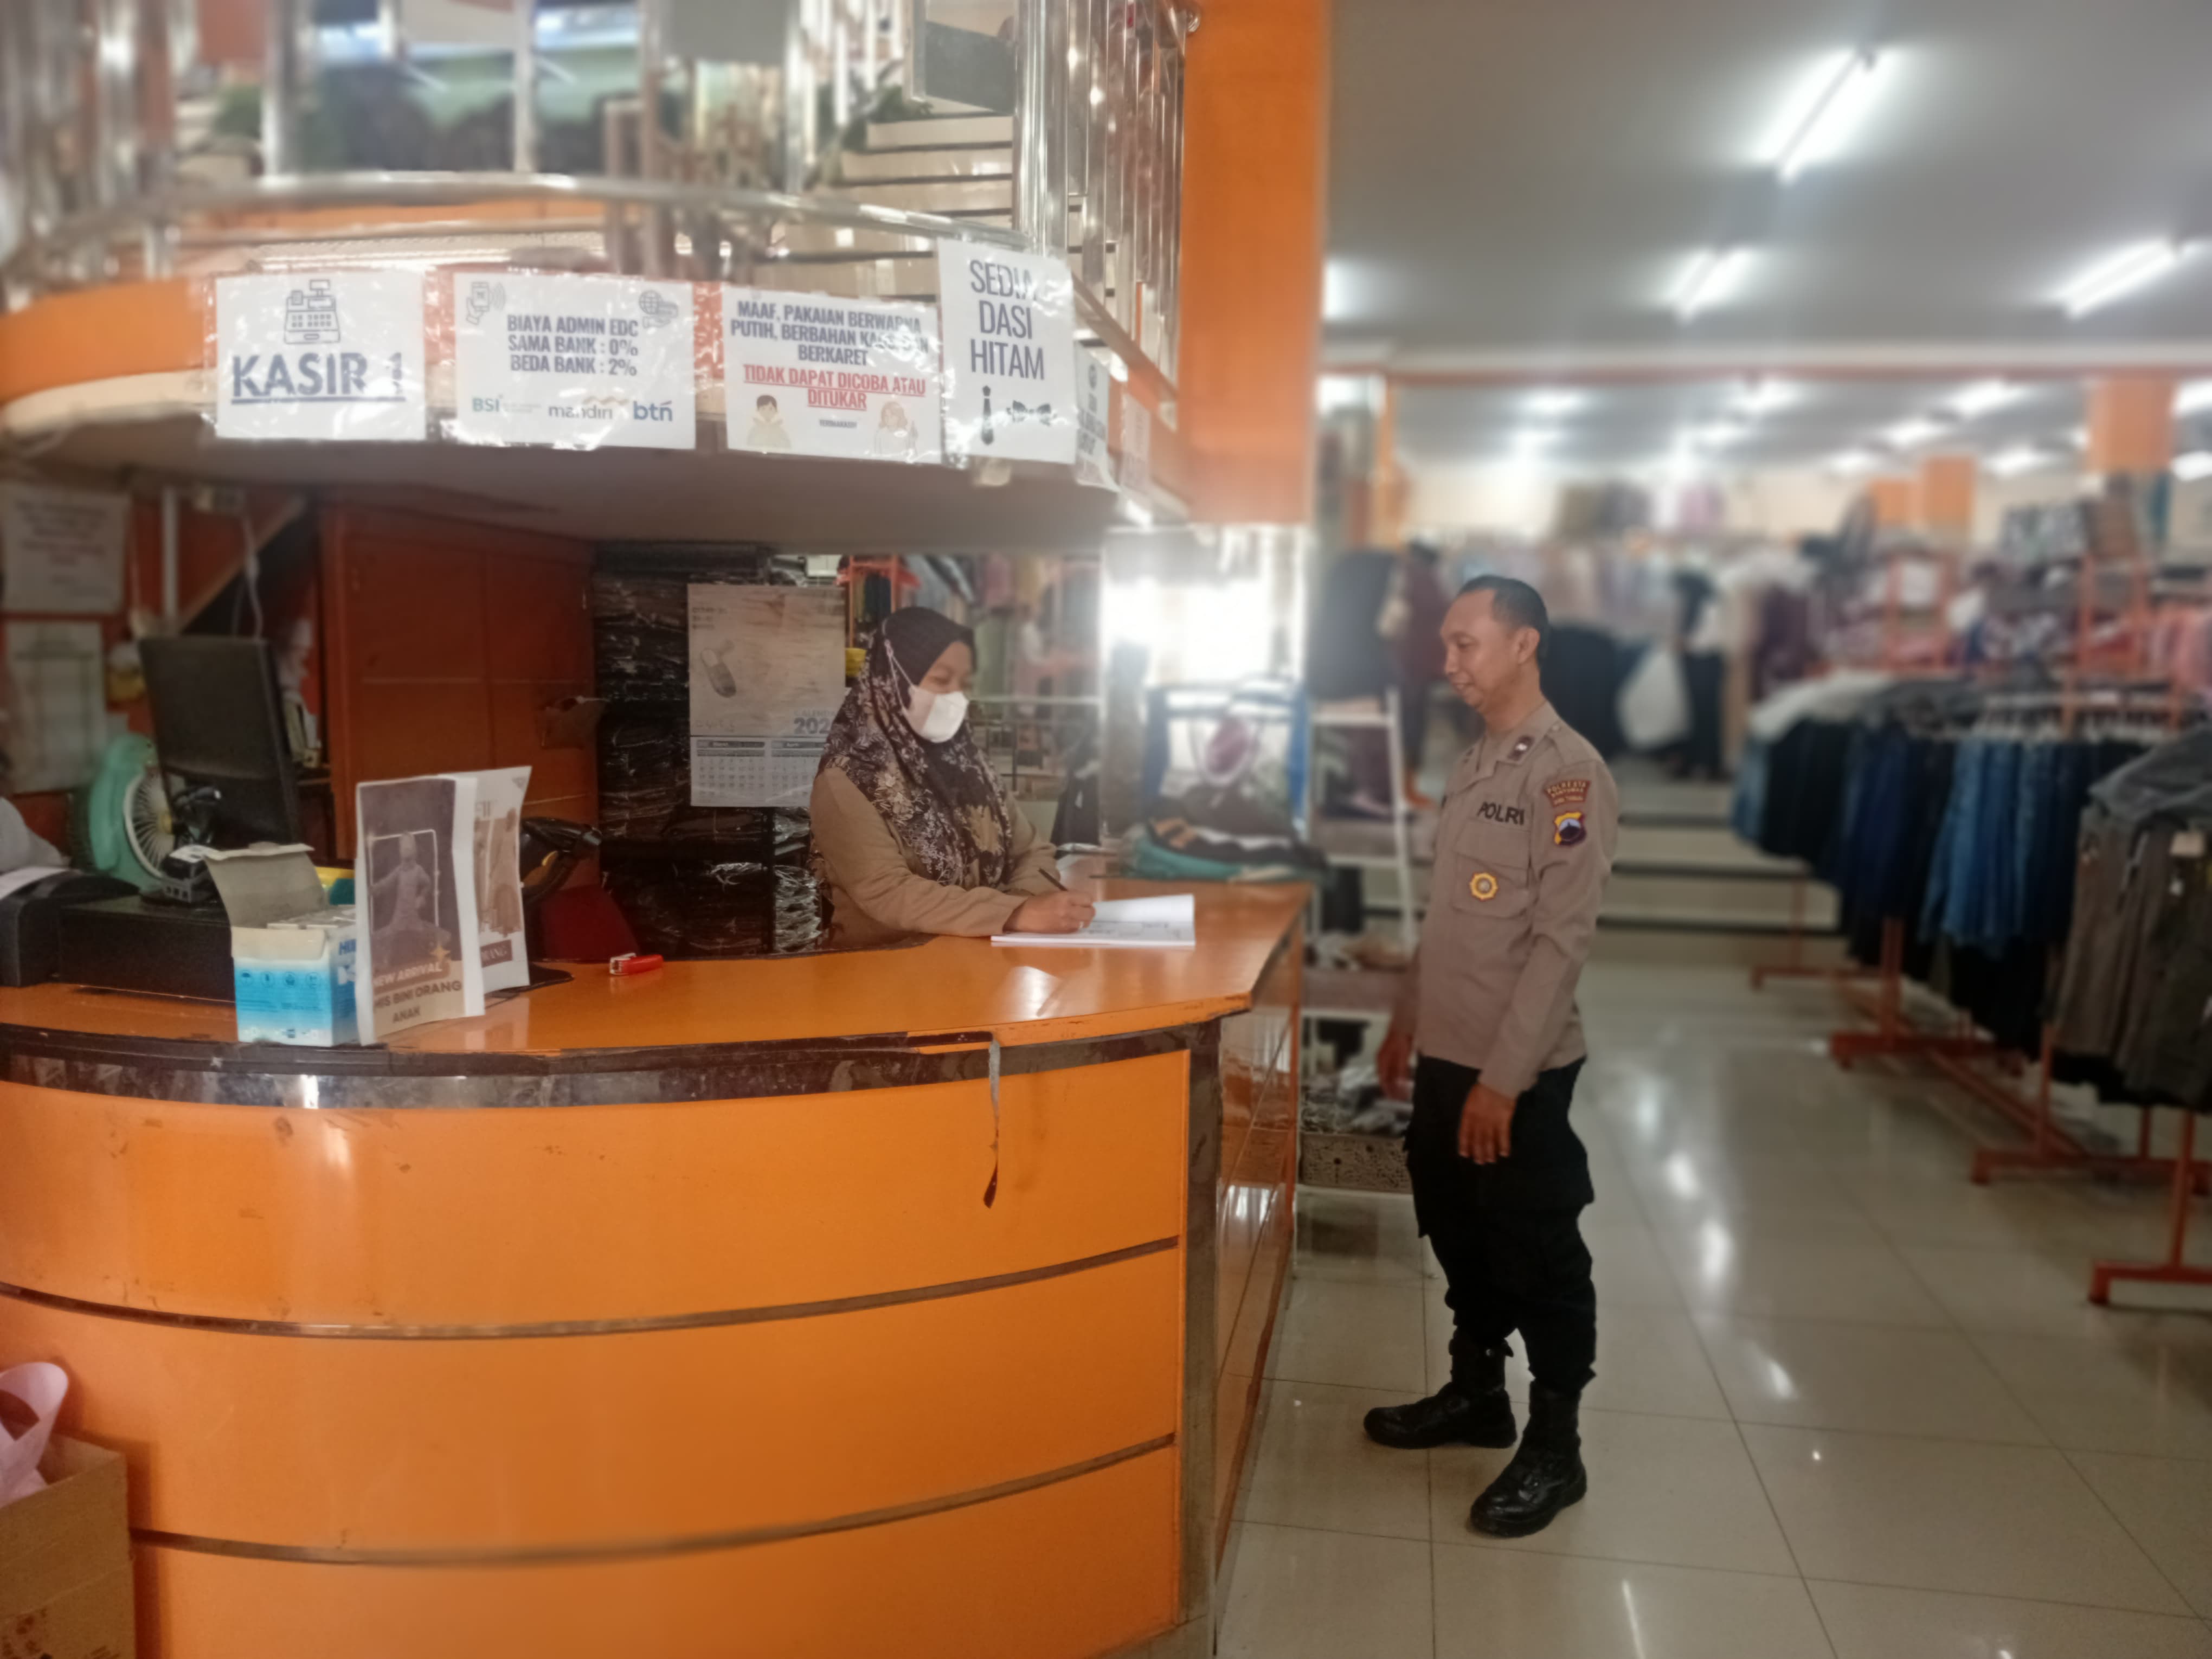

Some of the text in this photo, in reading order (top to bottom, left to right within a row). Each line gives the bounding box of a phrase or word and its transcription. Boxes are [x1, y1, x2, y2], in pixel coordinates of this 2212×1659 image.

[970, 260, 1037, 301] SEDIA
[737, 300, 781, 322] MAAF,
[783, 304, 845, 326] PAKAIAN
[979, 300, 1033, 340] DASI
[507, 314, 640, 337] BIAYA ADMIN EDC
[730, 319, 778, 342] PUTIH,
[781, 324, 857, 346] BERBAHAN
[508, 335, 551, 352] SAMA
[555, 337, 597, 354] BANK
[608, 339, 639, 356] 0%
[798, 344, 869, 366] BERKARET
[510, 355, 550, 372] BEDA
[554, 357, 596, 374] BANK
[608, 358, 638, 376] 2%
[970, 338, 1045, 381] HITAM
[232, 352, 402, 397] KASIR 1
[743, 364, 927, 395] TIDAK DAPAT DICOBA ATAU
[472, 397, 500, 413] BSI
[807, 388, 867, 410] DITUKAR
[633, 401, 673, 422] btn
[793, 717, 831, 735] 202
[1477, 801, 1525, 826] POLRI
[397, 962, 443, 981] ARRIVAL
[415, 980, 462, 998] ORANG
[392, 1006, 421, 1024] ANAK
